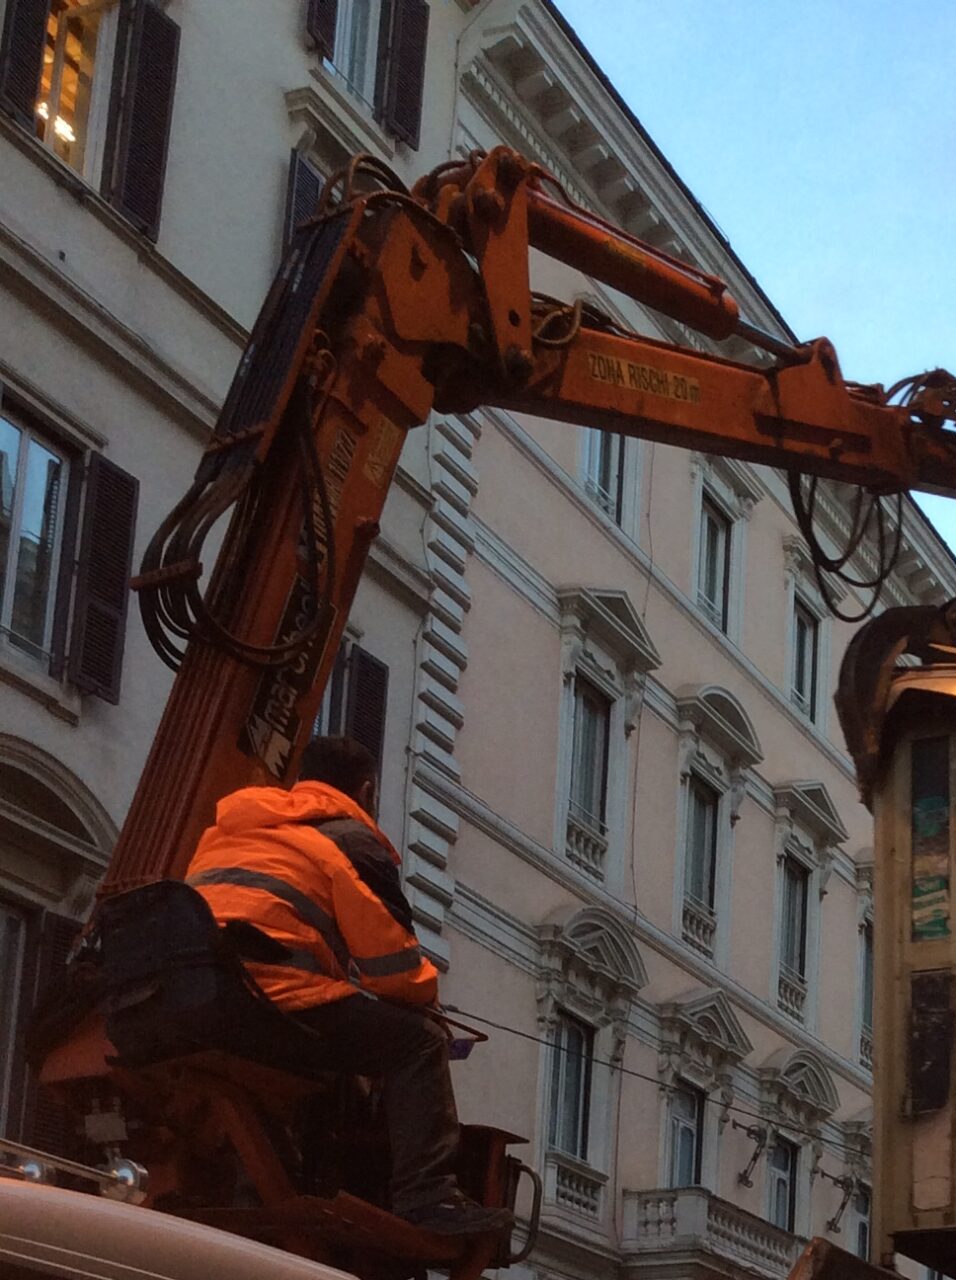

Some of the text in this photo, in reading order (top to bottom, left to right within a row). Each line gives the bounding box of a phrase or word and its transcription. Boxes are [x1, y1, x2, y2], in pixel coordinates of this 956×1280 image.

[589, 354, 624, 384] ZONA
[628, 363, 670, 395] RISCHI
[673, 375, 688, 400] 20
